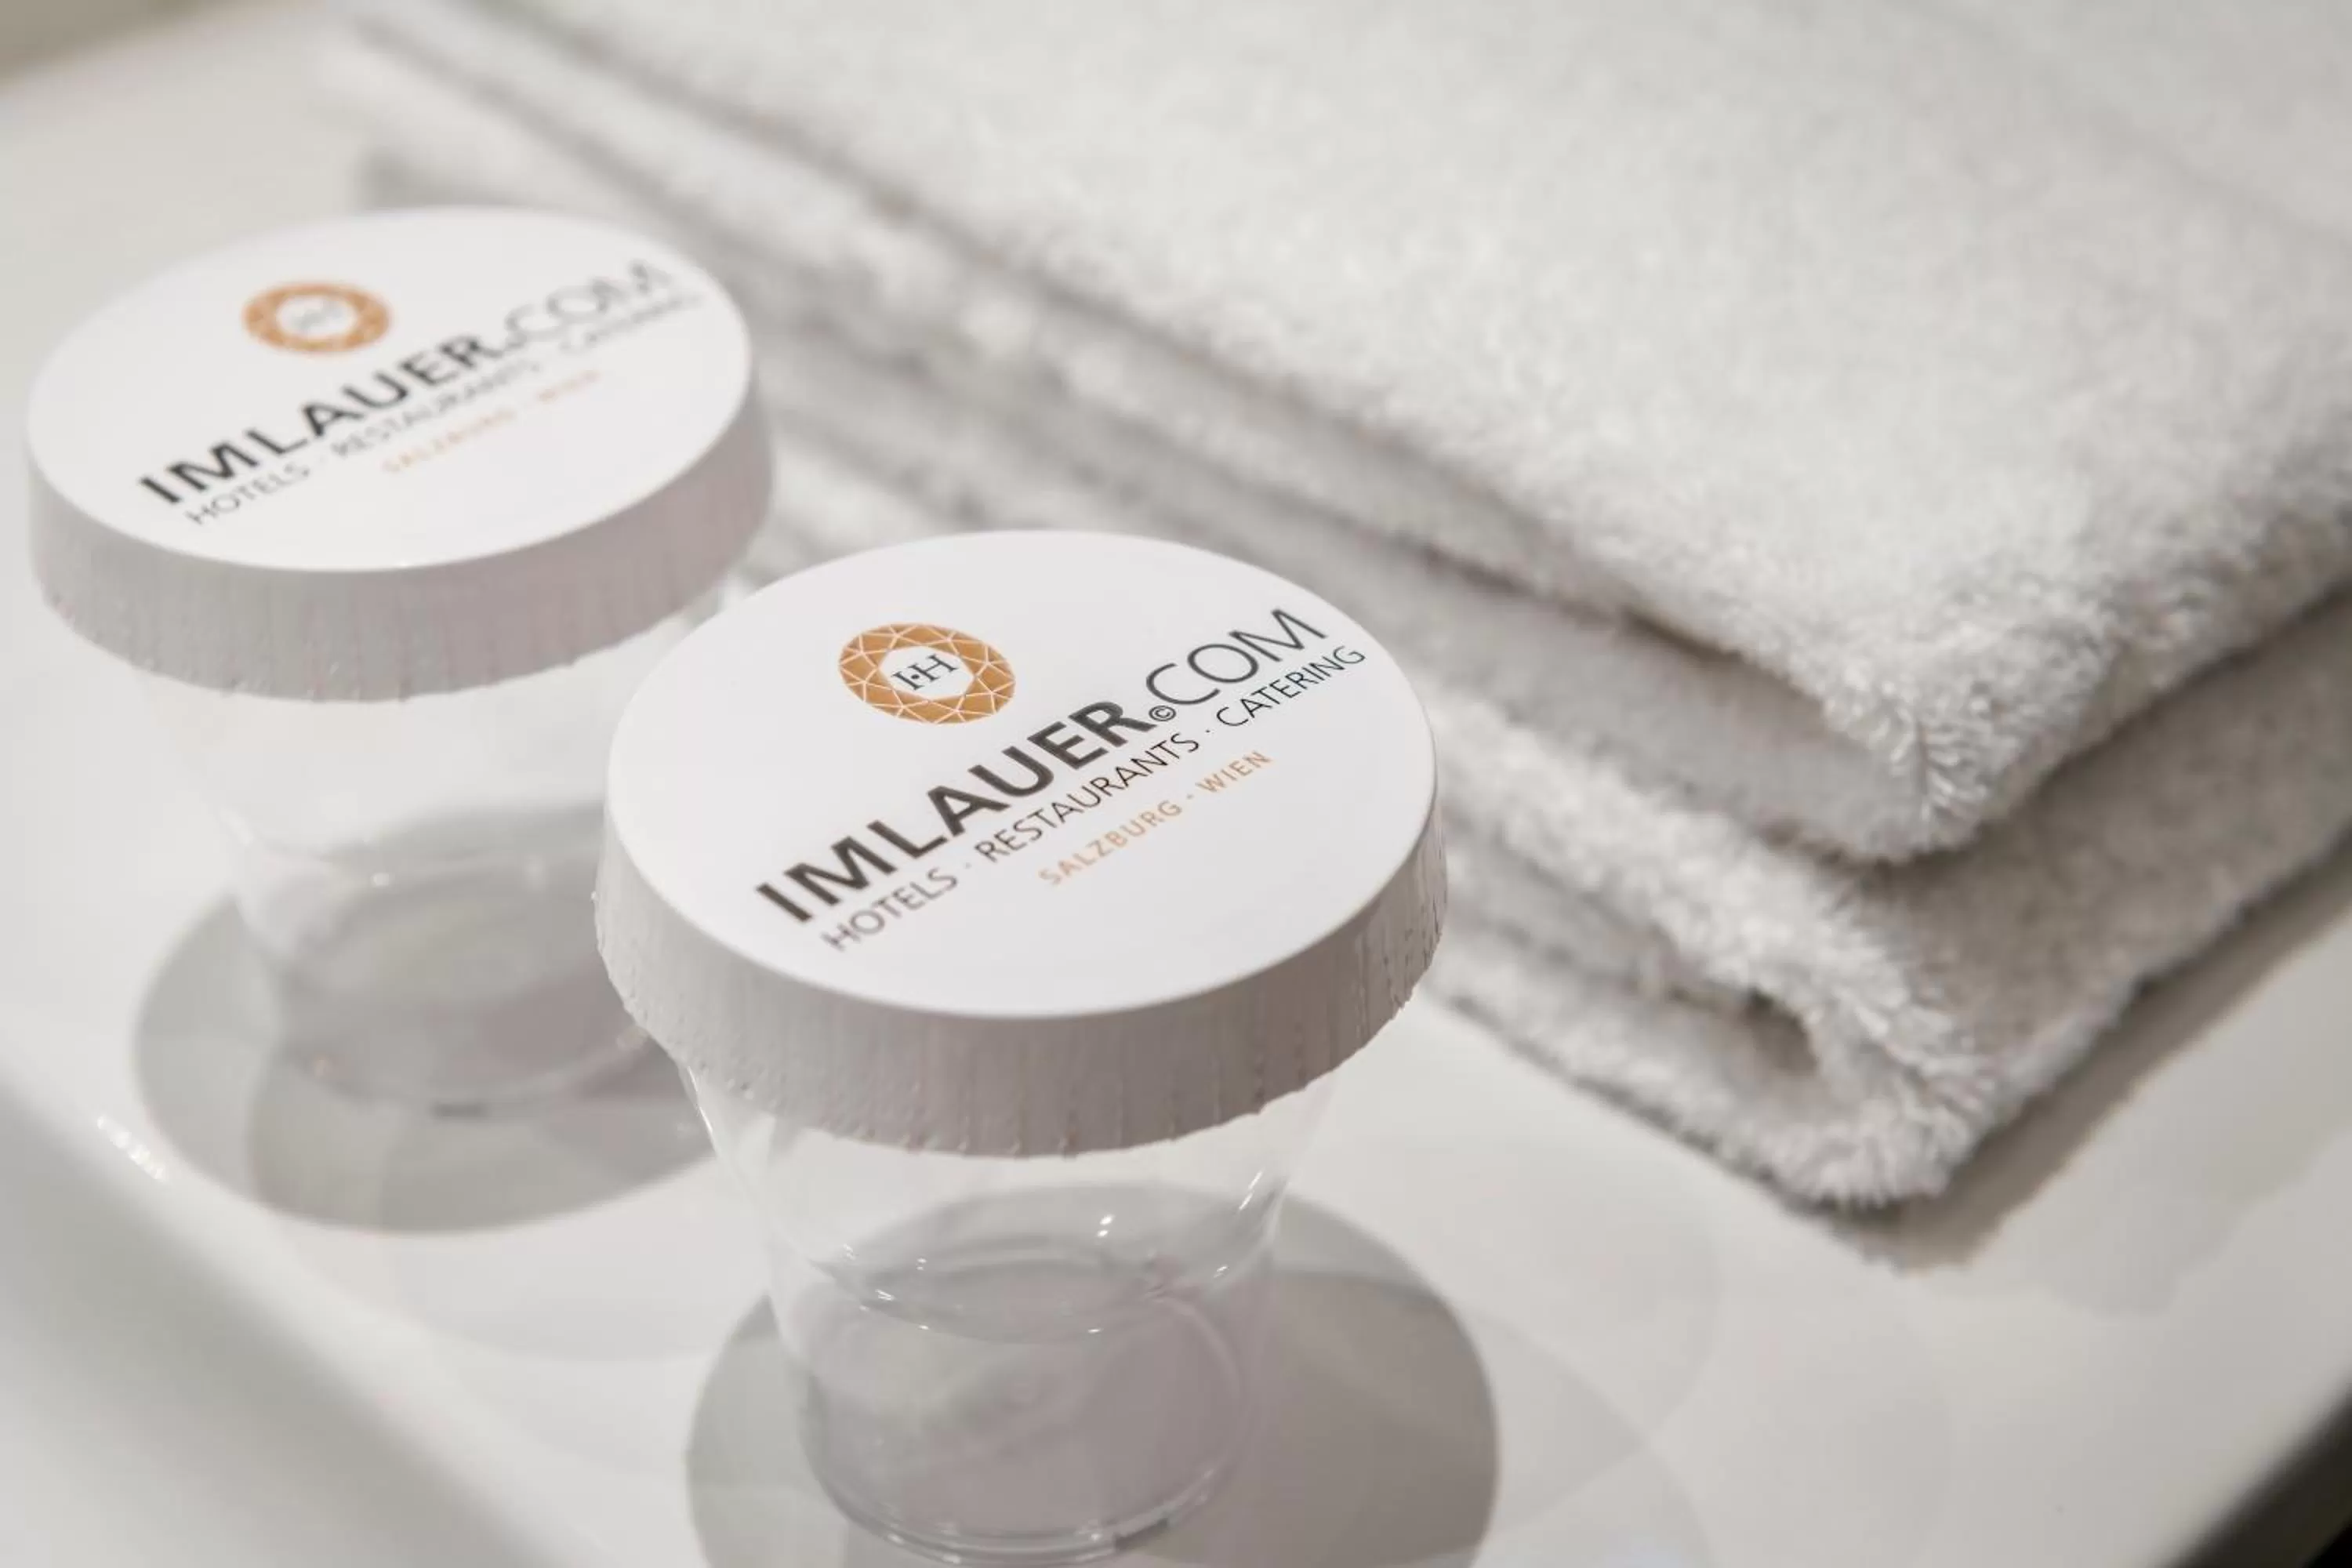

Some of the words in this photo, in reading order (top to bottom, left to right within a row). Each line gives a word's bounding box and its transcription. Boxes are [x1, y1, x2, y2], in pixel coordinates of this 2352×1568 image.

[187, 461, 310, 525] HOTELS
[821, 868, 958, 951] HOTELS
[974, 732, 1200, 864] RESTAURANTS
[1216, 645, 1366, 727] CATERING
[1037, 800, 1183, 886] SALZBURG
[1195, 750, 1273, 793] WIEN
